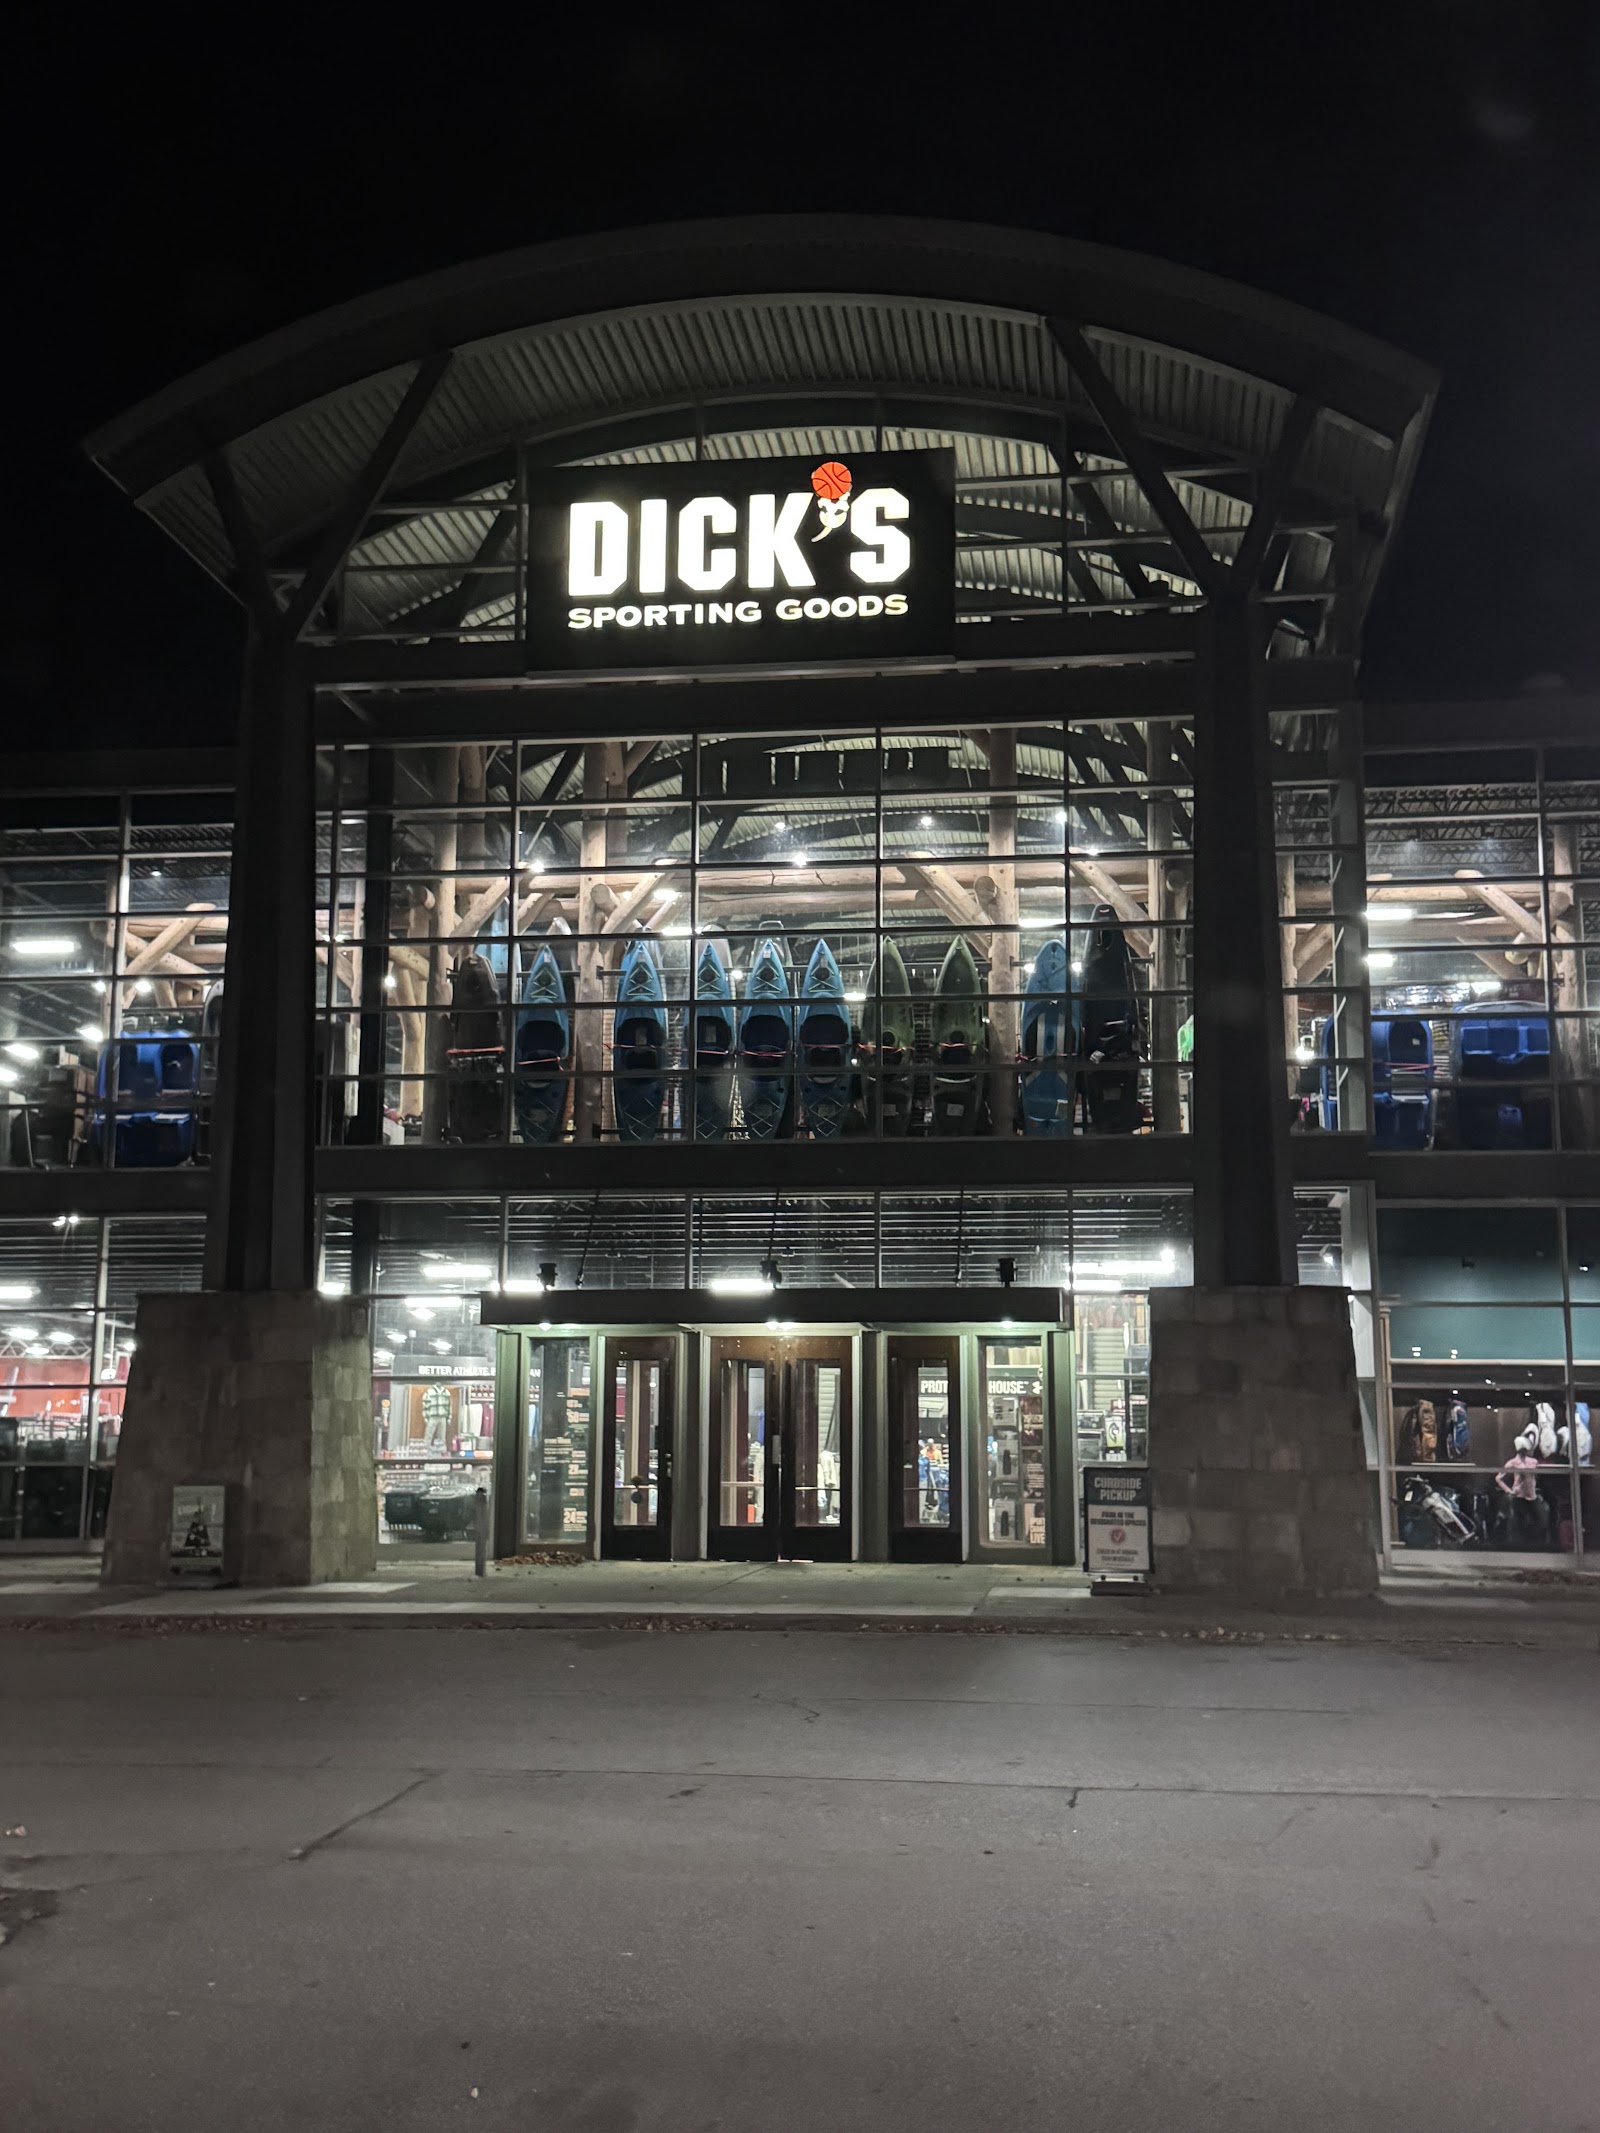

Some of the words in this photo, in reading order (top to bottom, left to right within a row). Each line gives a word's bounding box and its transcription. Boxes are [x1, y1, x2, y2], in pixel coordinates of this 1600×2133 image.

[568, 487, 911, 597] DICK'S
[568, 601, 762, 629] SPORTING
[776, 594, 909, 621] GOODS
[418, 1365, 453, 1376] BETTER
[1094, 1477, 1142, 1490] CURBSIDE
[1100, 1489, 1137, 1501] PICKUP
